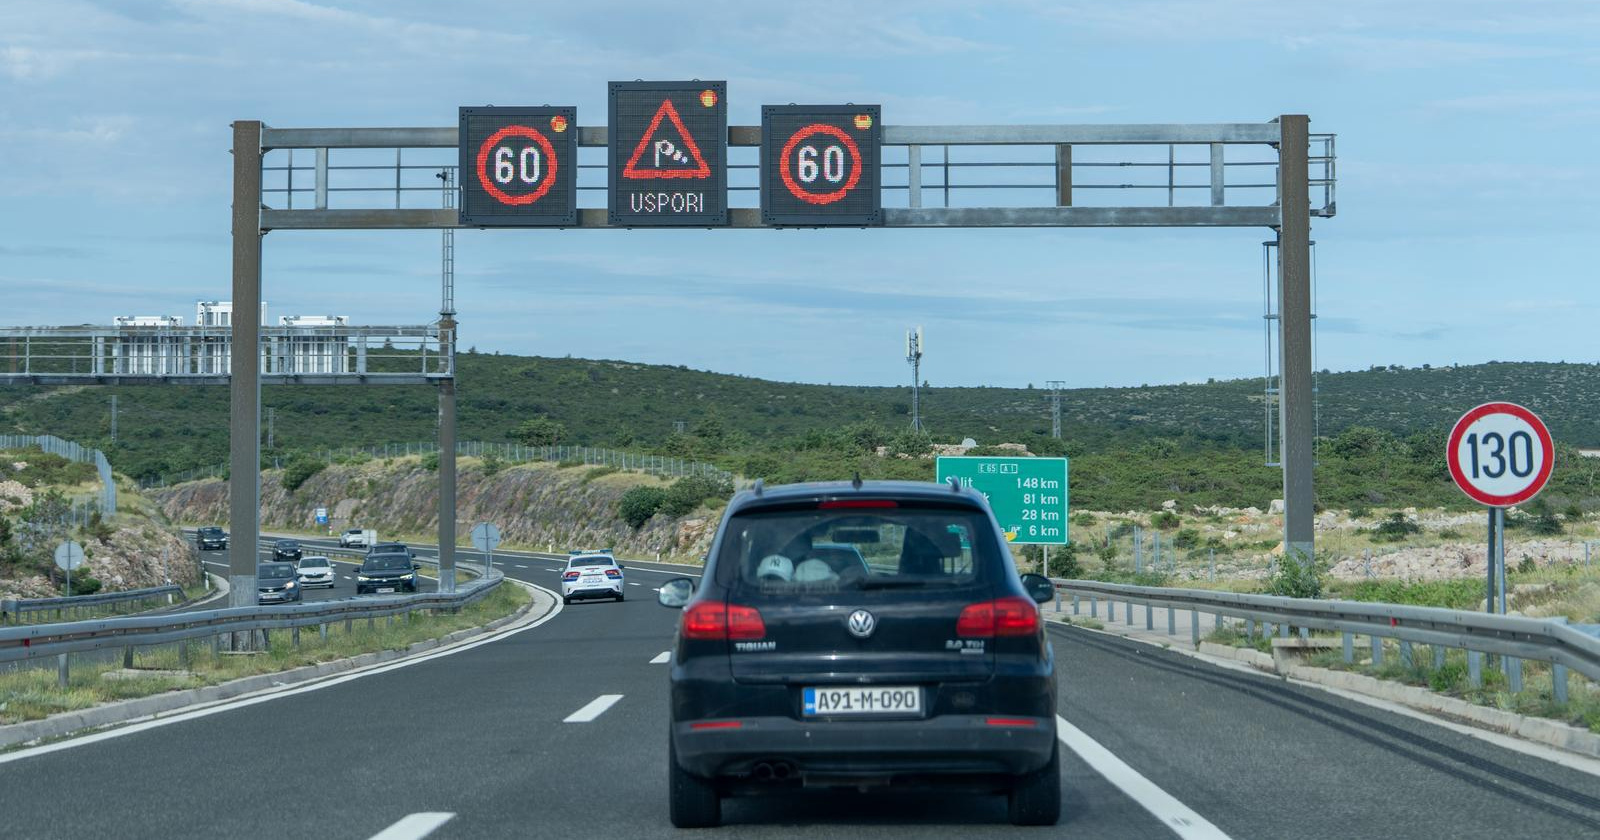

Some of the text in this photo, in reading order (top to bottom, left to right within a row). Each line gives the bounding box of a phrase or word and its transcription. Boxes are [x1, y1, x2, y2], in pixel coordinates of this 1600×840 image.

[495, 147, 541, 184] 60
[799, 145, 845, 182] 60
[631, 192, 704, 213] USPORI
[1466, 430, 1534, 479] 130
[945, 476, 1059, 489] Slit 148 km
[1023, 493, 1059, 504] 81 km
[1022, 509, 1059, 520] 28 km
[1029, 525, 1059, 536] 6 km
[818, 691, 916, 709] A91-M-090
